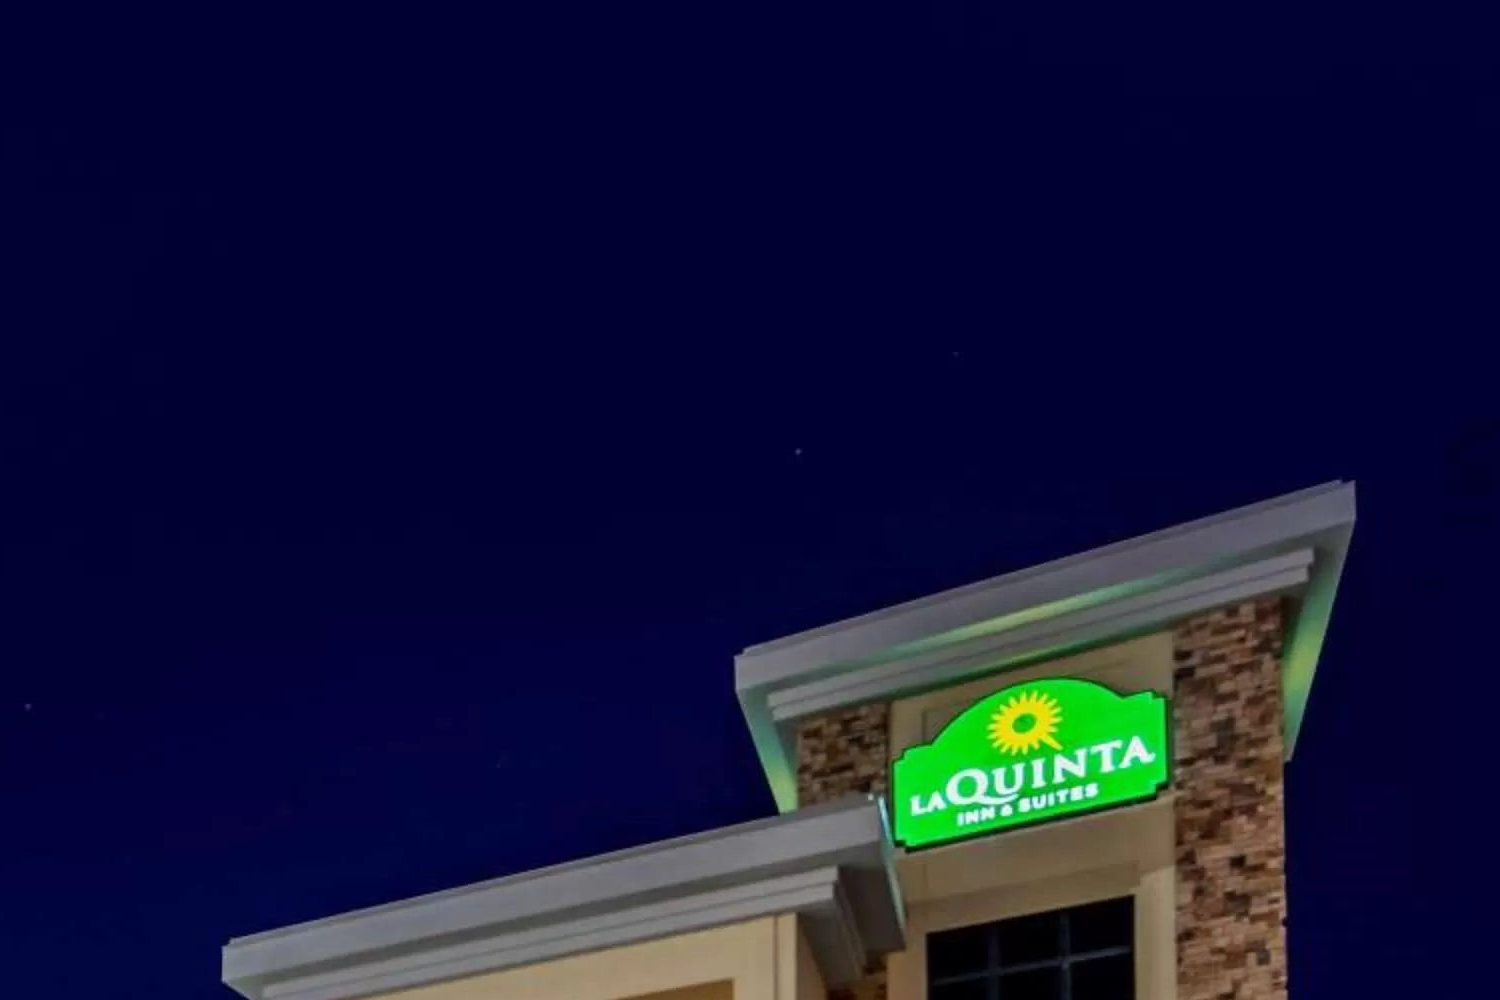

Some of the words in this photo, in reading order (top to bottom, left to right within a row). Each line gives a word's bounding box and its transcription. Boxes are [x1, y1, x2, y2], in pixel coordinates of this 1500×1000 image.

[910, 790, 948, 816] LA
[945, 735, 1156, 806] QUINTA
[956, 806, 996, 827] INN
[1000, 803, 1014, 817] &
[1018, 782, 1099, 813] SUITES
